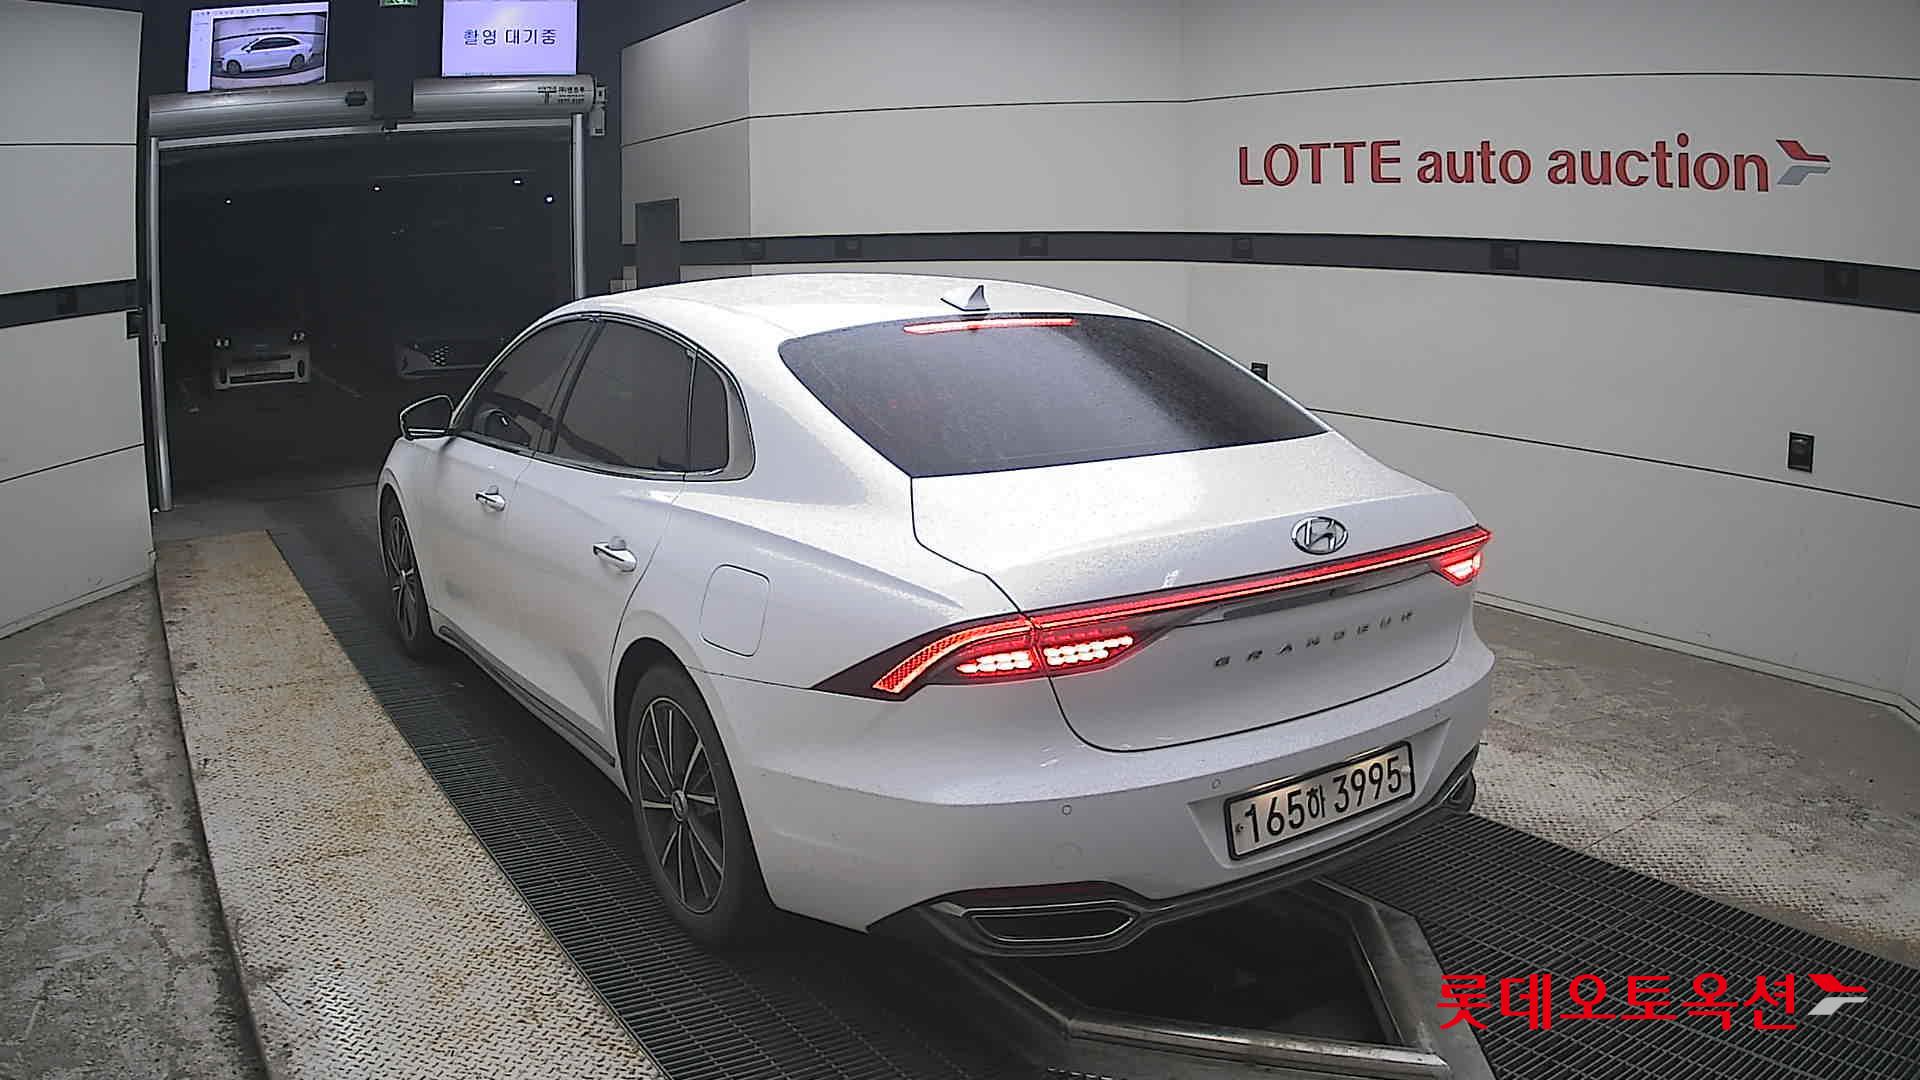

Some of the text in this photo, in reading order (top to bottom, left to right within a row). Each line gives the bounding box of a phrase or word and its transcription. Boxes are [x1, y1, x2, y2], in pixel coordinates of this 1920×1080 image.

[463, 28, 557, 46] 촬영 대기중
[1239, 133, 1770, 192] LOTTE auto auction
[1213, 611, 1413, 668] GRANDEUR
[1244, 755, 1402, 843] 165하 3995
